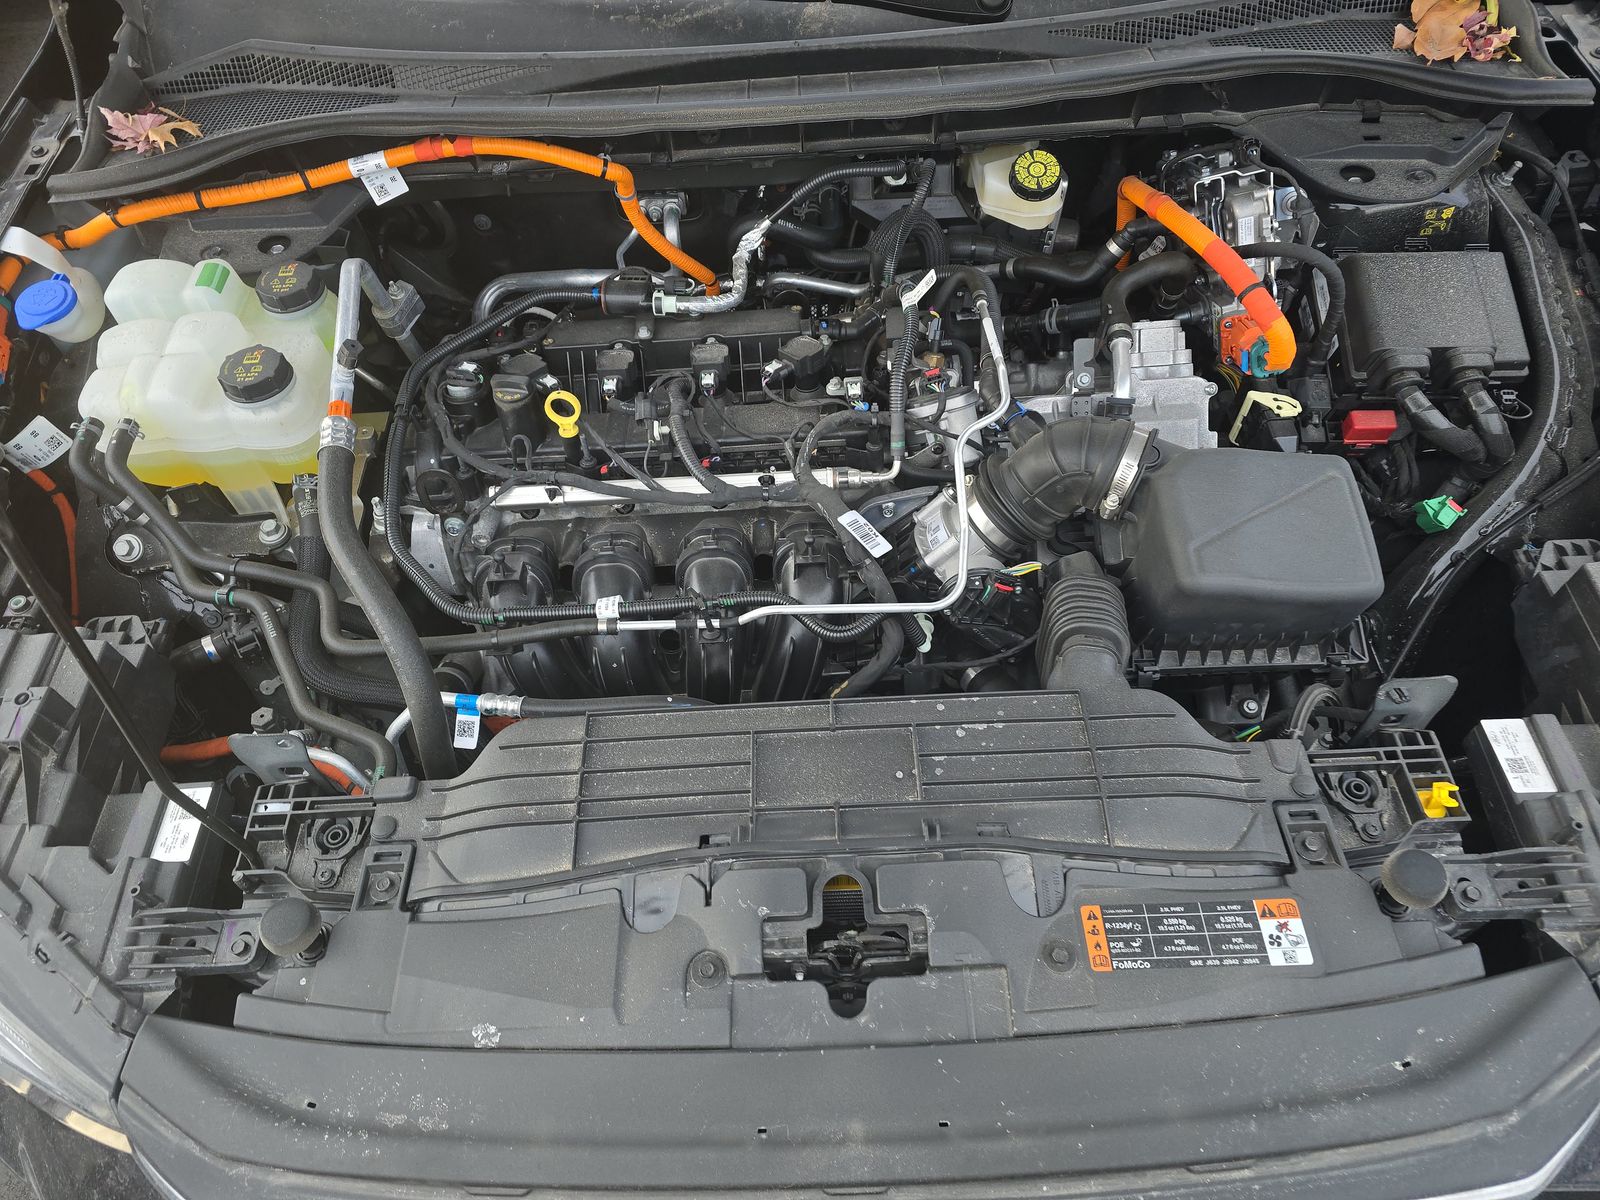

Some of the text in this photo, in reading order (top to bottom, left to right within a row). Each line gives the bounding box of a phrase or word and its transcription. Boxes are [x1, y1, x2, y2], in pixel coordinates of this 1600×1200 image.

[389, 175, 398, 184] RE
[1104, 922, 1133, 930] R-1234yf
[1112, 959, 1151, 970] FoMoCo
